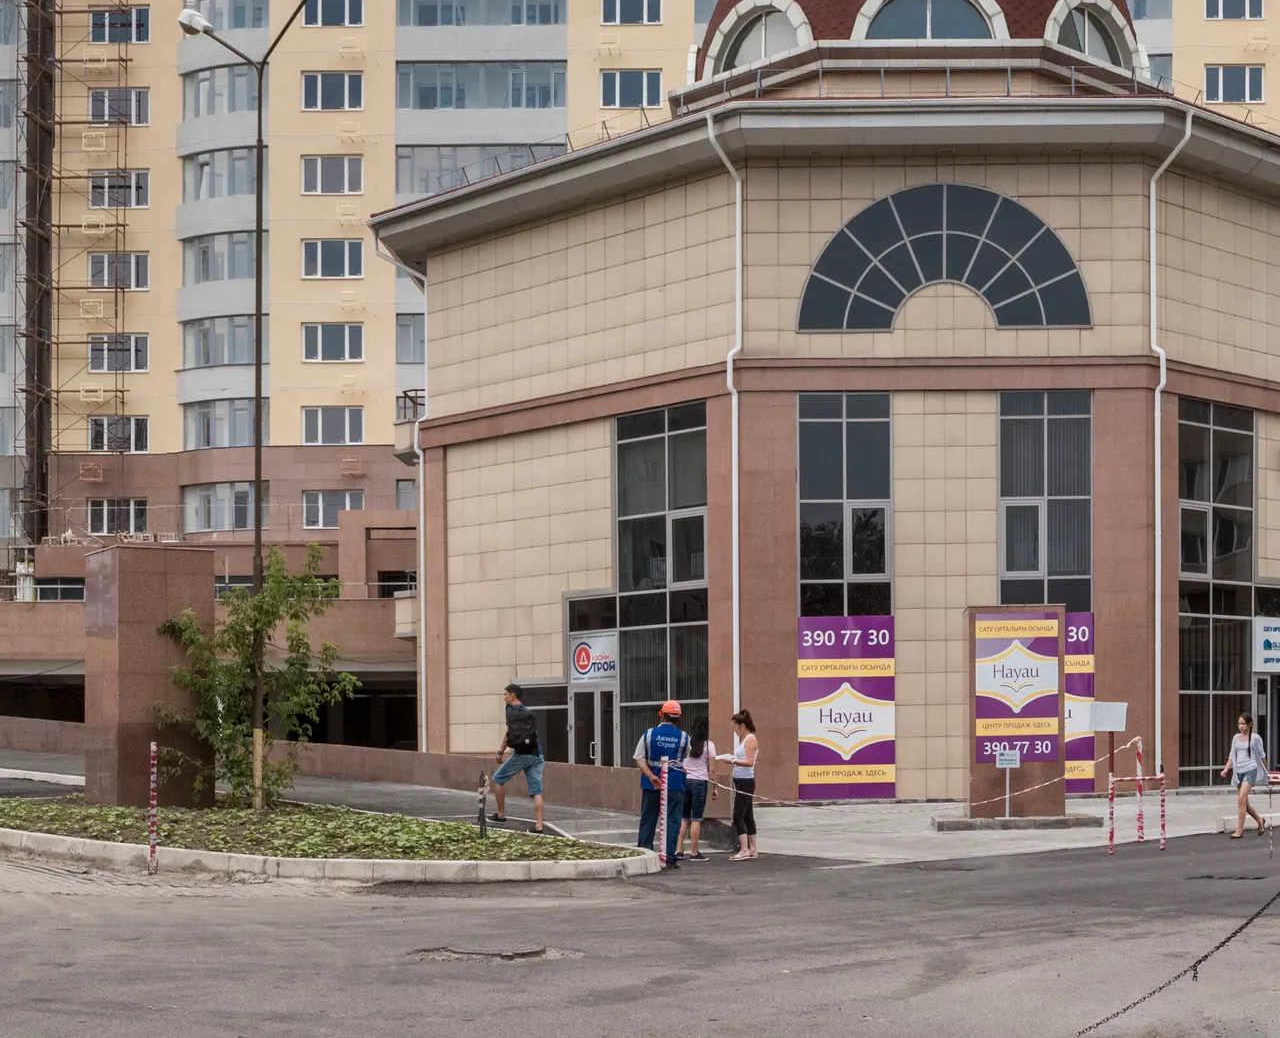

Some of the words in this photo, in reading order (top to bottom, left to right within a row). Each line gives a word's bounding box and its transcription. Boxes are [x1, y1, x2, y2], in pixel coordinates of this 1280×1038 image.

[995, 625, 1027, 633] ОРТАЛЫҒЫ
[1067, 625, 1089, 642] 30
[802, 630, 836, 646] 390
[840, 629, 862, 646] 77
[867, 629, 890, 646] 30
[860, 663, 891, 671] ОСЫНДА
[993, 664, 1040, 684] Hayau
[819, 708, 874, 729] Hayau
[1003, 722, 1032, 730] ПРОДАЖ
[1033, 721, 1052, 729] ЗДЕСЬ
[983, 741, 1009, 755] 390
[1013, 741, 1030, 754] 77
[1034, 740, 1052, 754] 30
[807, 770, 831, 778] ЦЕНТР
[865, 769, 887, 777] ЗДЕСЬ
